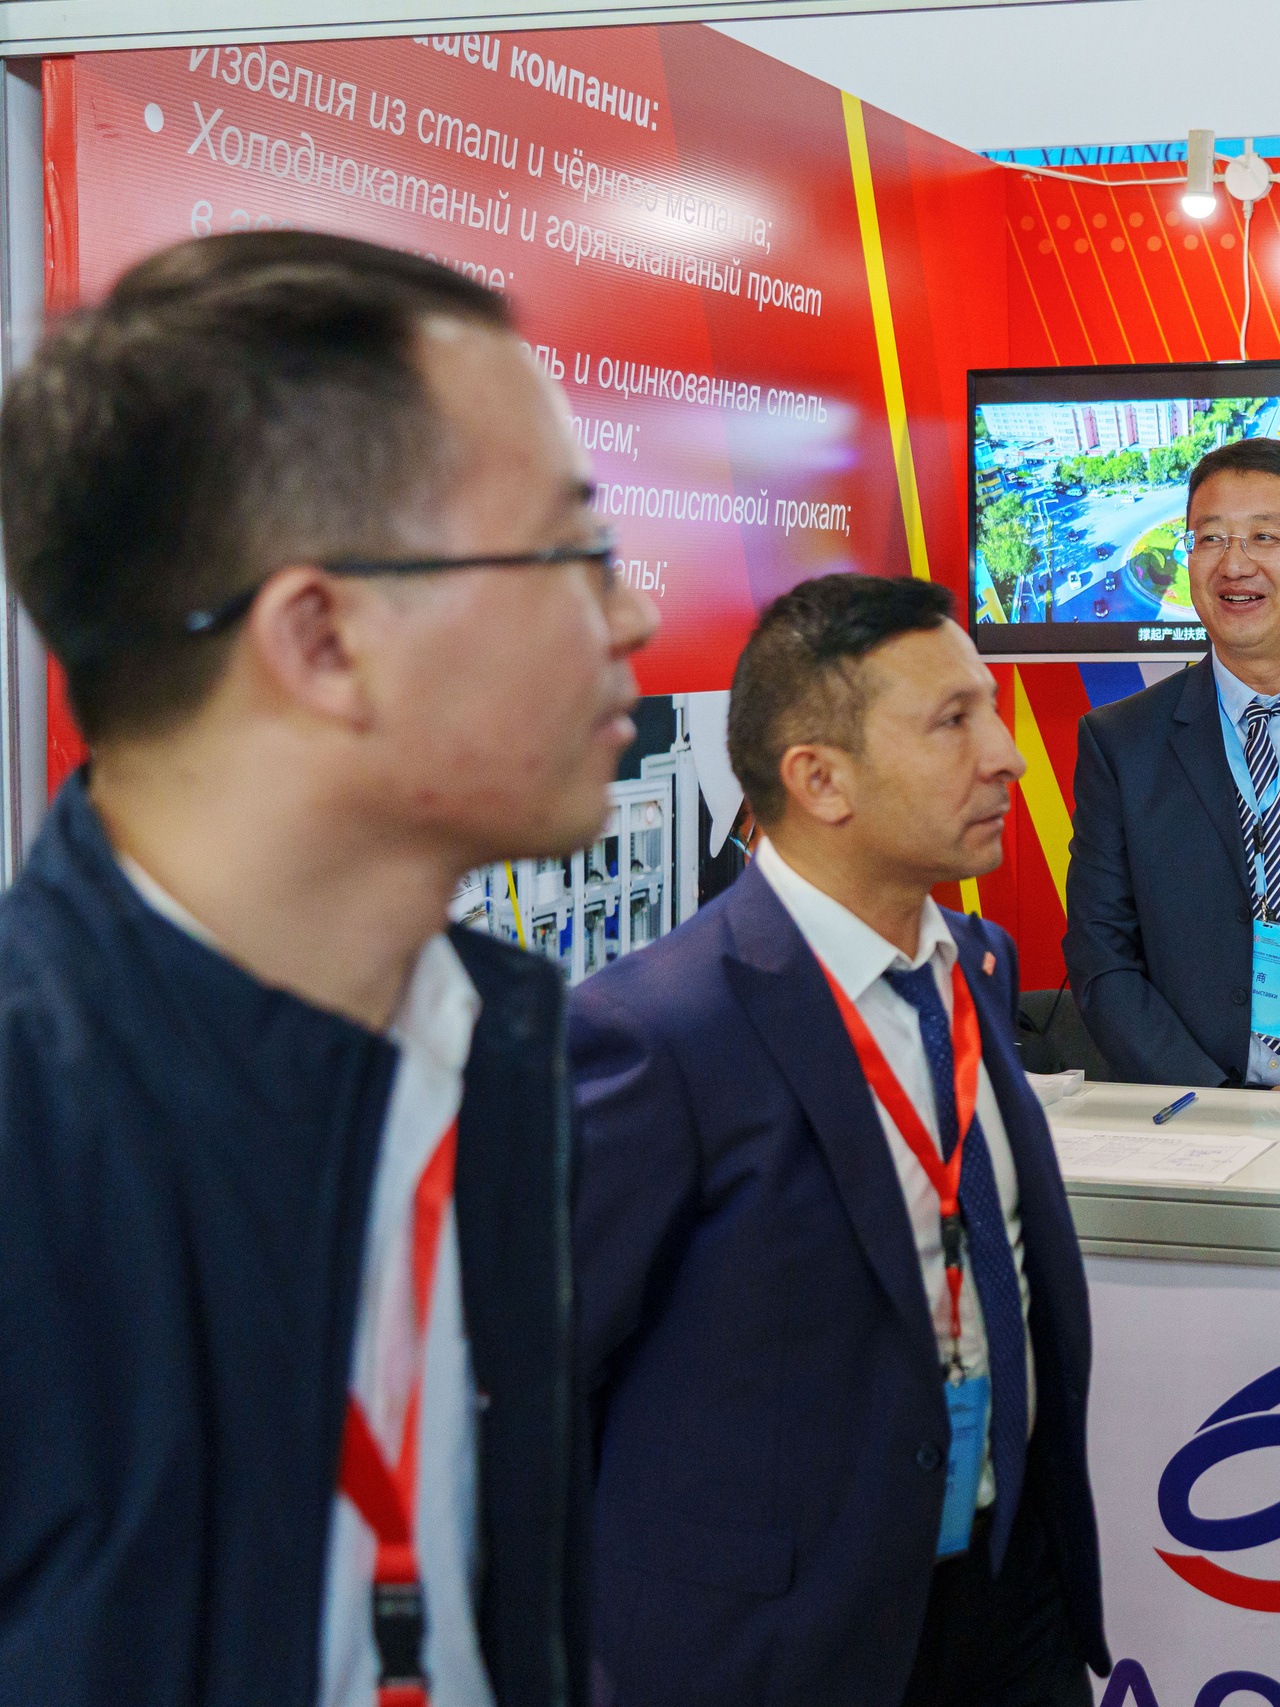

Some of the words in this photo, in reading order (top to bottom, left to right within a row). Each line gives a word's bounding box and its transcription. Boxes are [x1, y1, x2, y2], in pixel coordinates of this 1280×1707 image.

[510, 45, 659, 131] компании:
[189, 46, 357, 120] Изделия
[369, 92, 406, 135] из
[417, 108, 518, 169] стали
[528, 143, 544, 177] и
[553, 148, 657, 212] чёрного
[187, 102, 511, 235] Холоднокатаный
[520, 208, 537, 242] и
[546, 216, 742, 296] горячекатаный
[748, 272, 822, 316] прокат
[574, 352, 590, 385] и
[598, 357, 761, 413] оцинкованная
[767, 388, 828, 424] сталь
[774, 499, 852, 538] прокат;
[1138, 627, 1207, 641] 撑起产业扶贫
